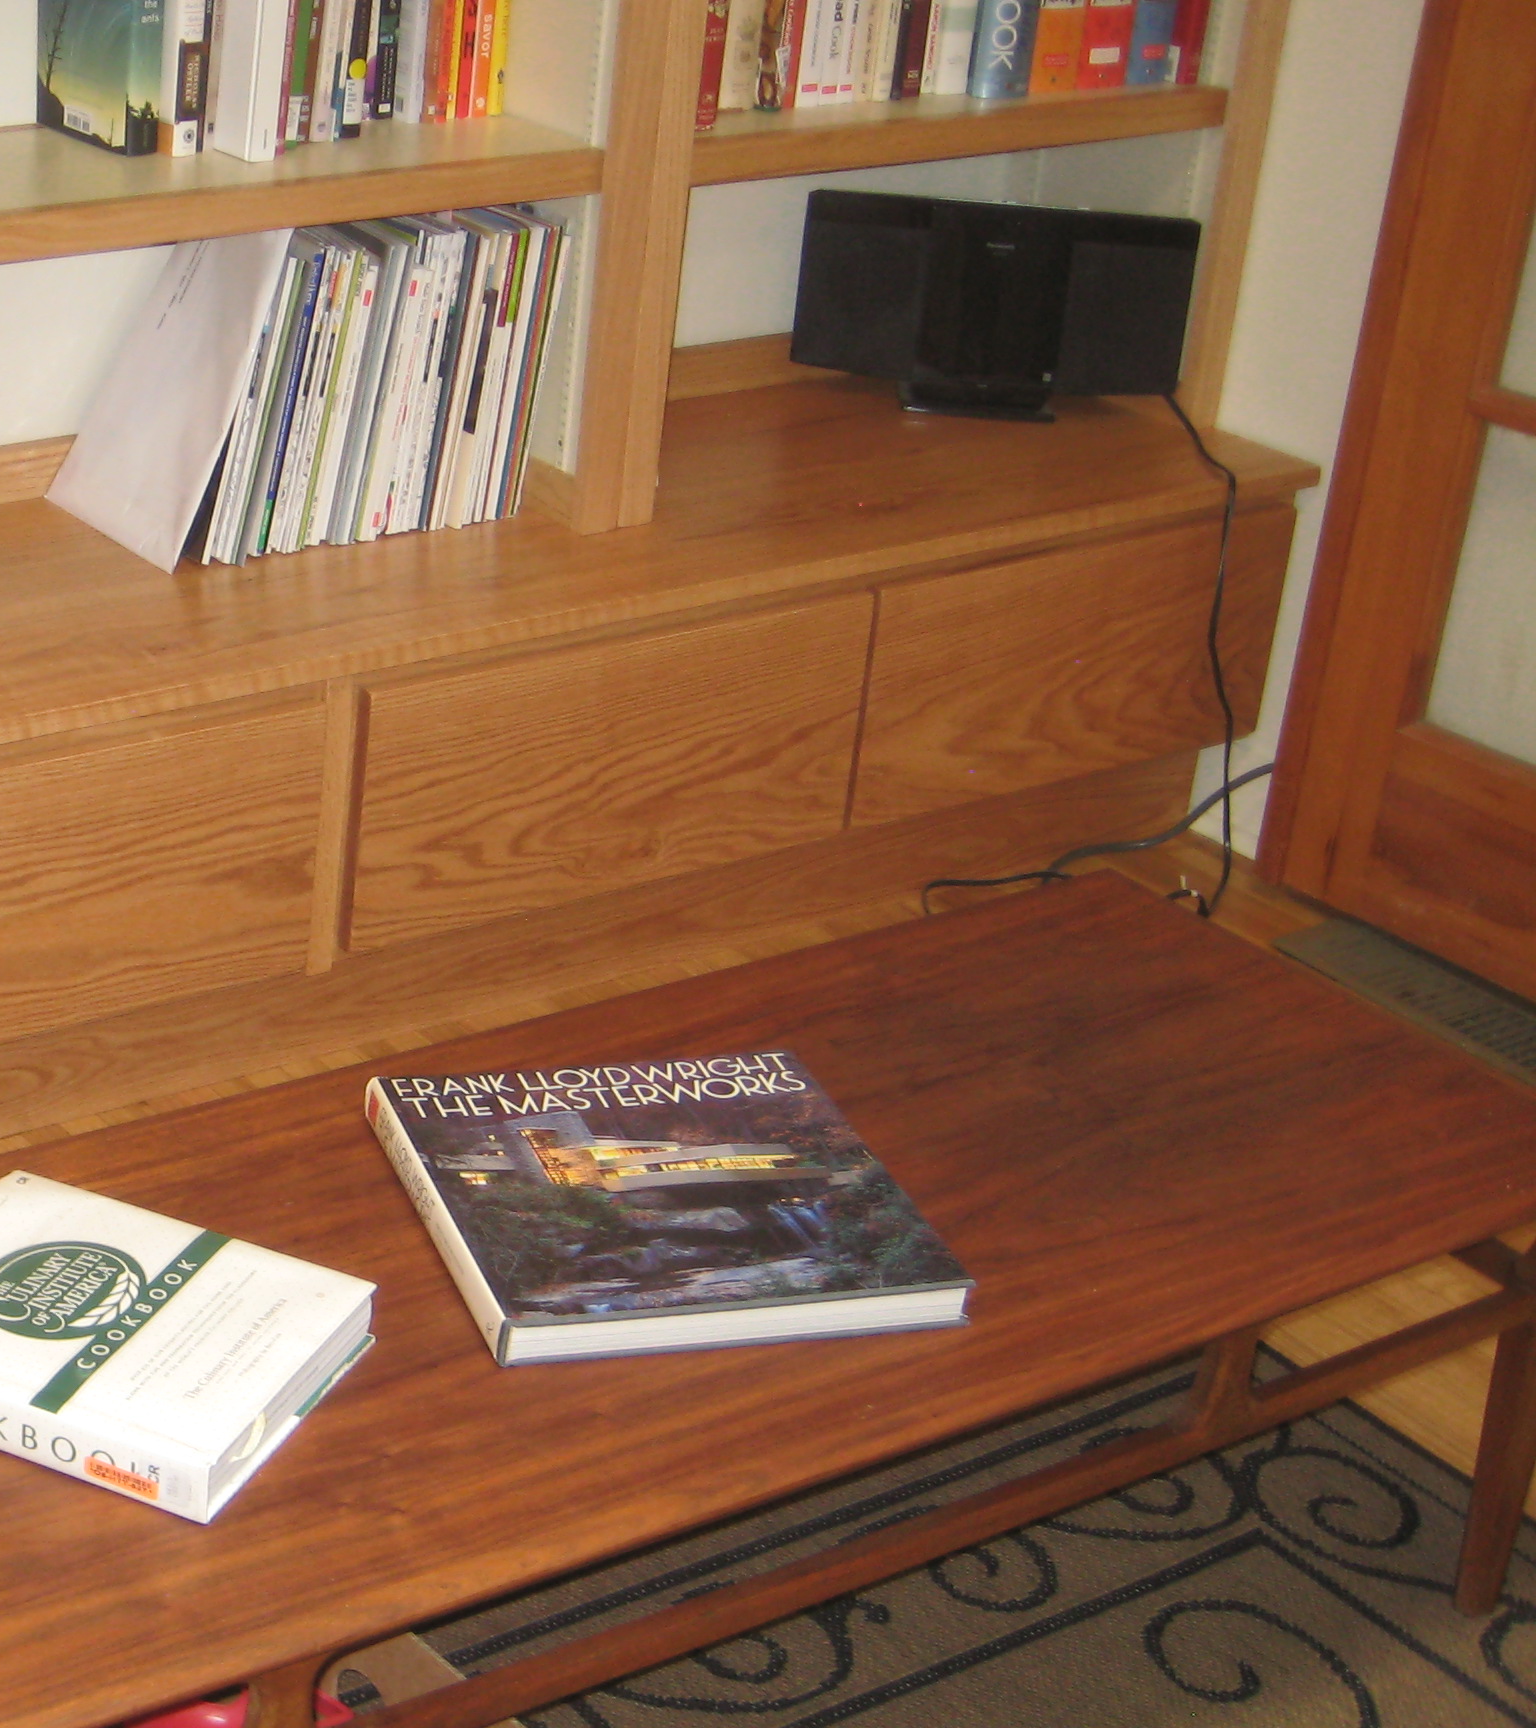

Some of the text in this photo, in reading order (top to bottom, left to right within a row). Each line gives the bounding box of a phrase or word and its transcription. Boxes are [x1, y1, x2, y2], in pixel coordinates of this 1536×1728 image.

[478, 12, 493, 57] savor
[826, 24, 842, 60] Cook
[391, 1053, 788, 1098] FRANK LLOYD WRIGHT
[402, 1071, 807, 1119] THE MASTERWORKS
[28, 1251, 103, 1311] INSTITUTE
[44, 1264, 118, 1333] AMERICA
[31, 1311, 51, 1326] OF
[77, 1259, 198, 1369] COOKBOOK
